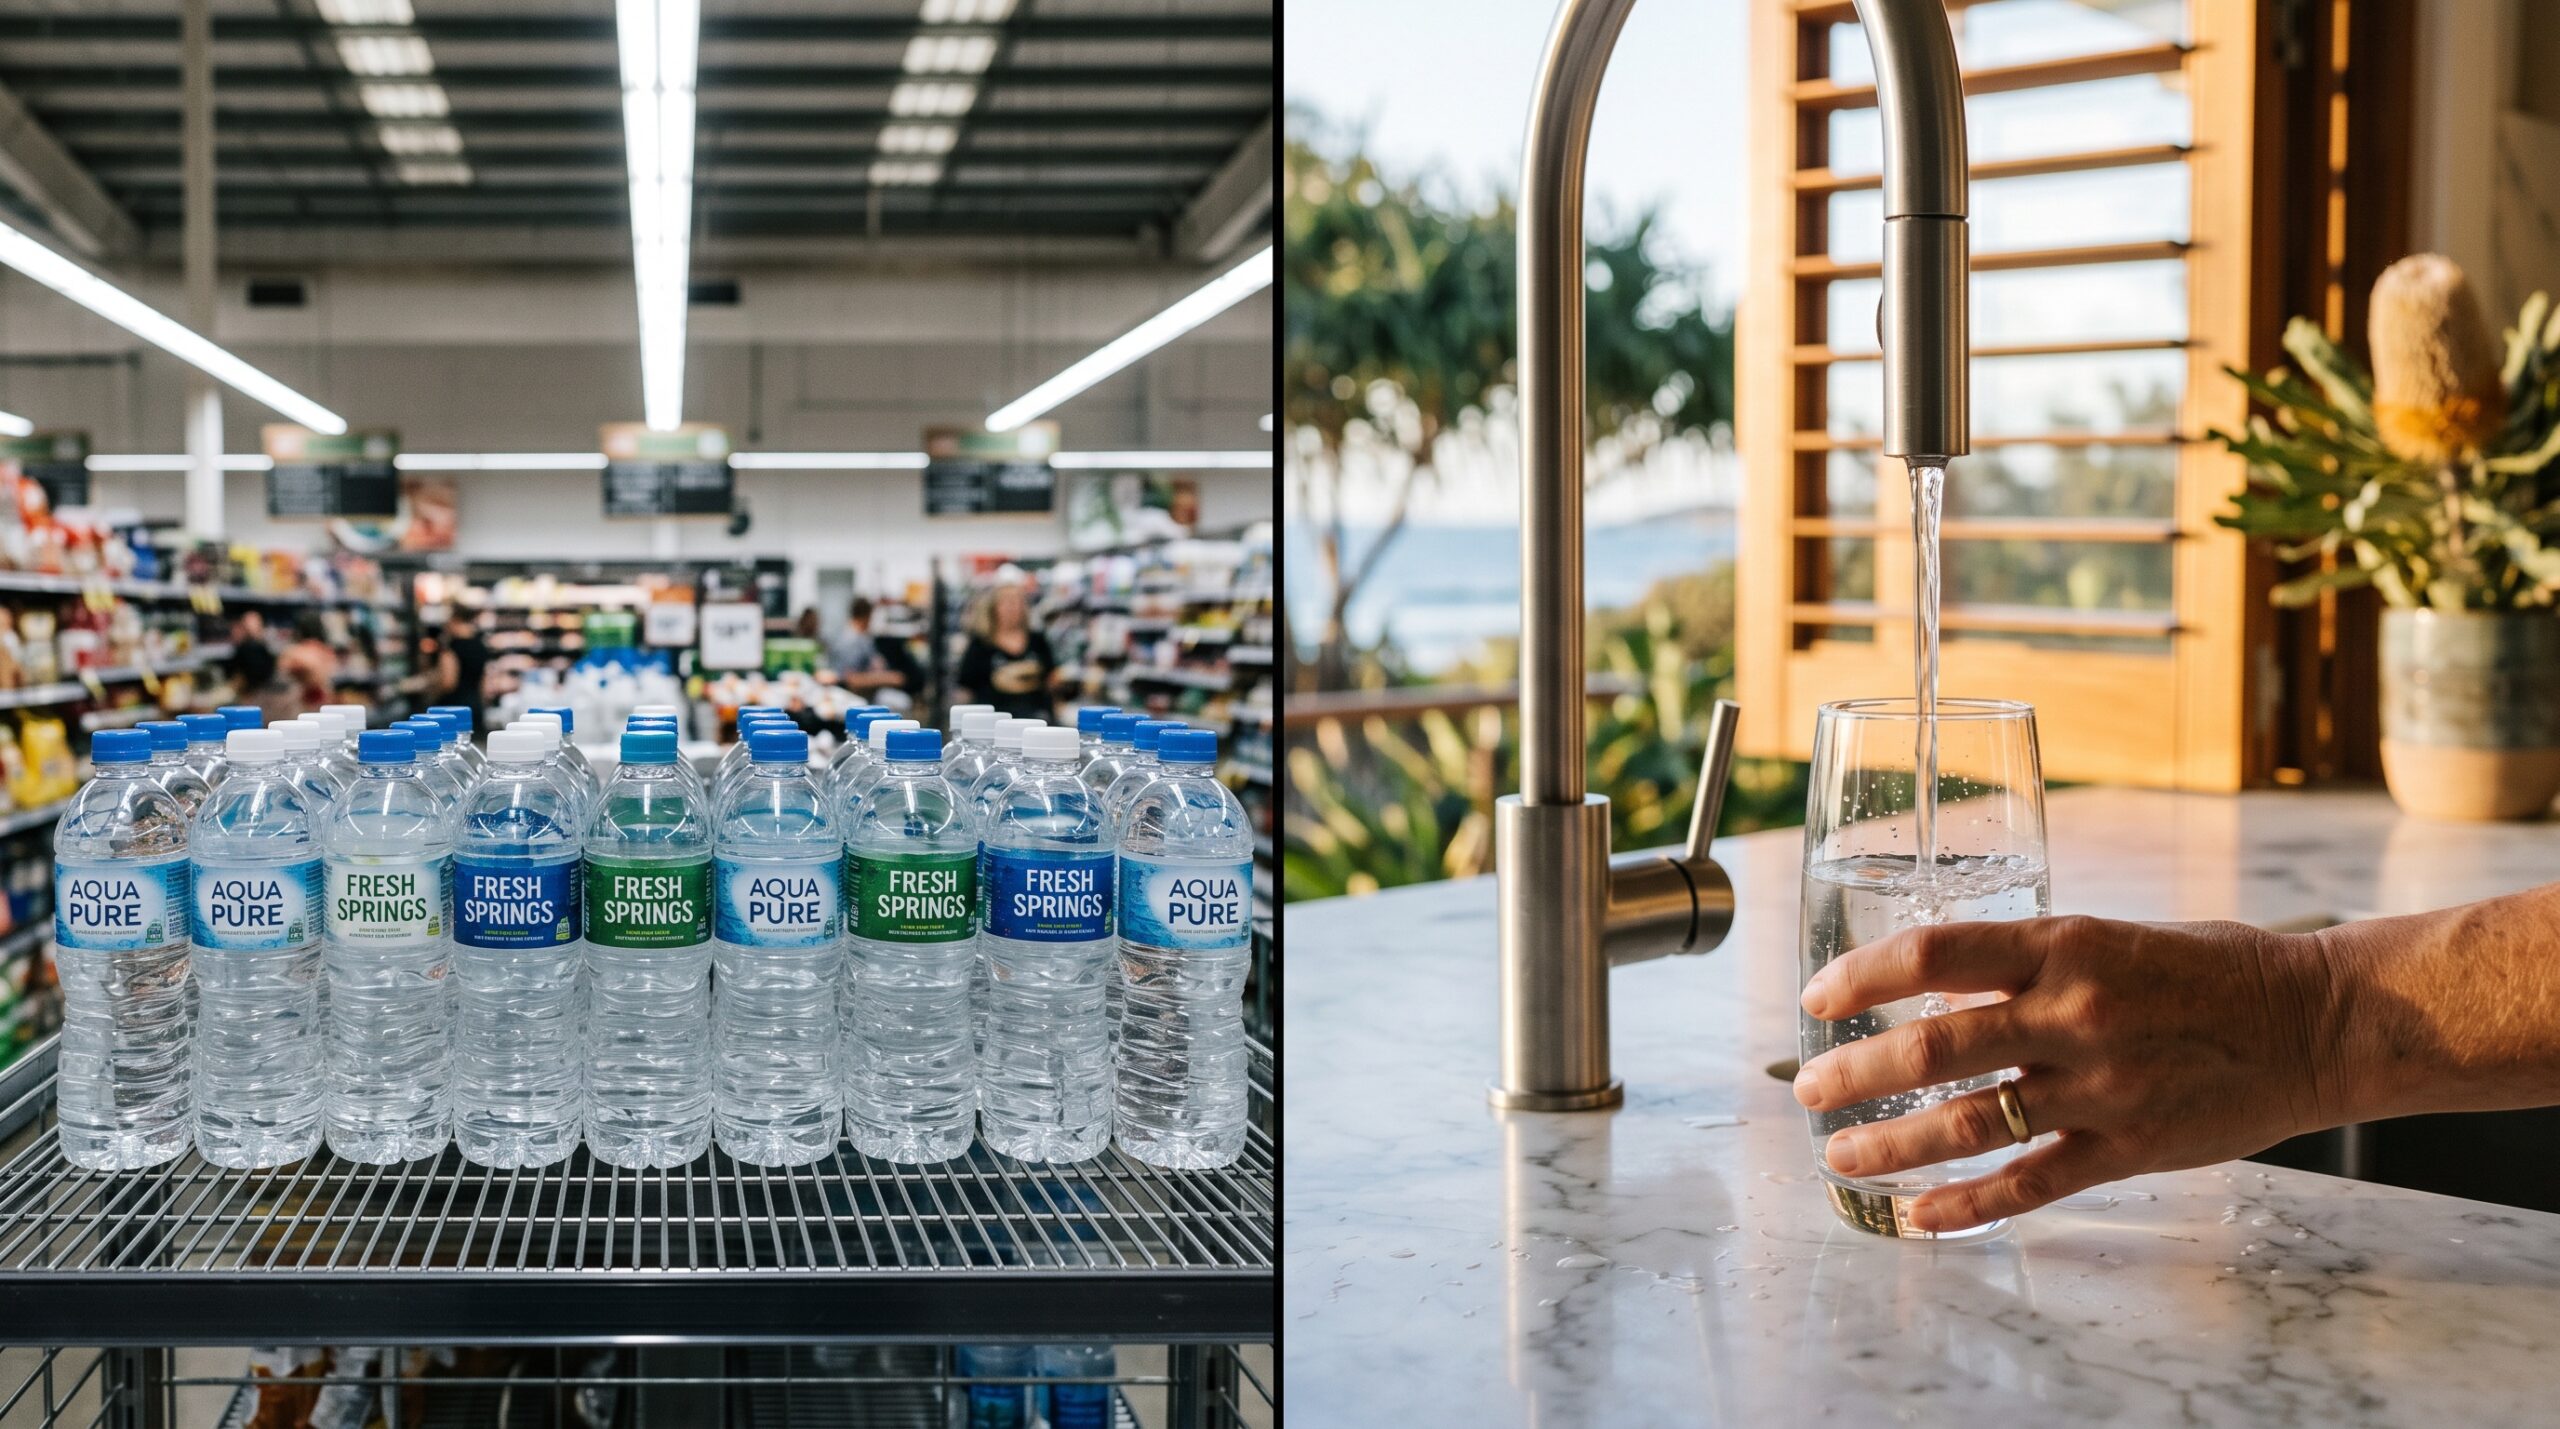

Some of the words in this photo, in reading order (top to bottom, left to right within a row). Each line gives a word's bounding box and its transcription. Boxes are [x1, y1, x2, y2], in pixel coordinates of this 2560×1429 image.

[70, 880, 140, 903] AQUA
[212, 880, 282, 904] AQUA
[347, 874, 415, 897] FRESH
[474, 876, 541, 900] FRESH
[614, 876, 682, 899] FRESH
[750, 878, 820, 902] AQUA
[889, 871, 957, 894] FRESH
[1026, 869, 1093, 893] FRESH
[1169, 879, 1238, 902] AQUA
[70, 903, 141, 926] PURE
[212, 903, 283, 926] PURE
[338, 898, 426, 922] SPRINGS
[465, 899, 554, 925] SPRINGS
[604, 900, 693, 925] SPRINGS
[750, 901, 820, 924] PURE
[878, 895, 965, 919] SPRINGS
[1014, 893, 1102, 918] SPRINGS
[1169, 902, 1238, 925] PURE
